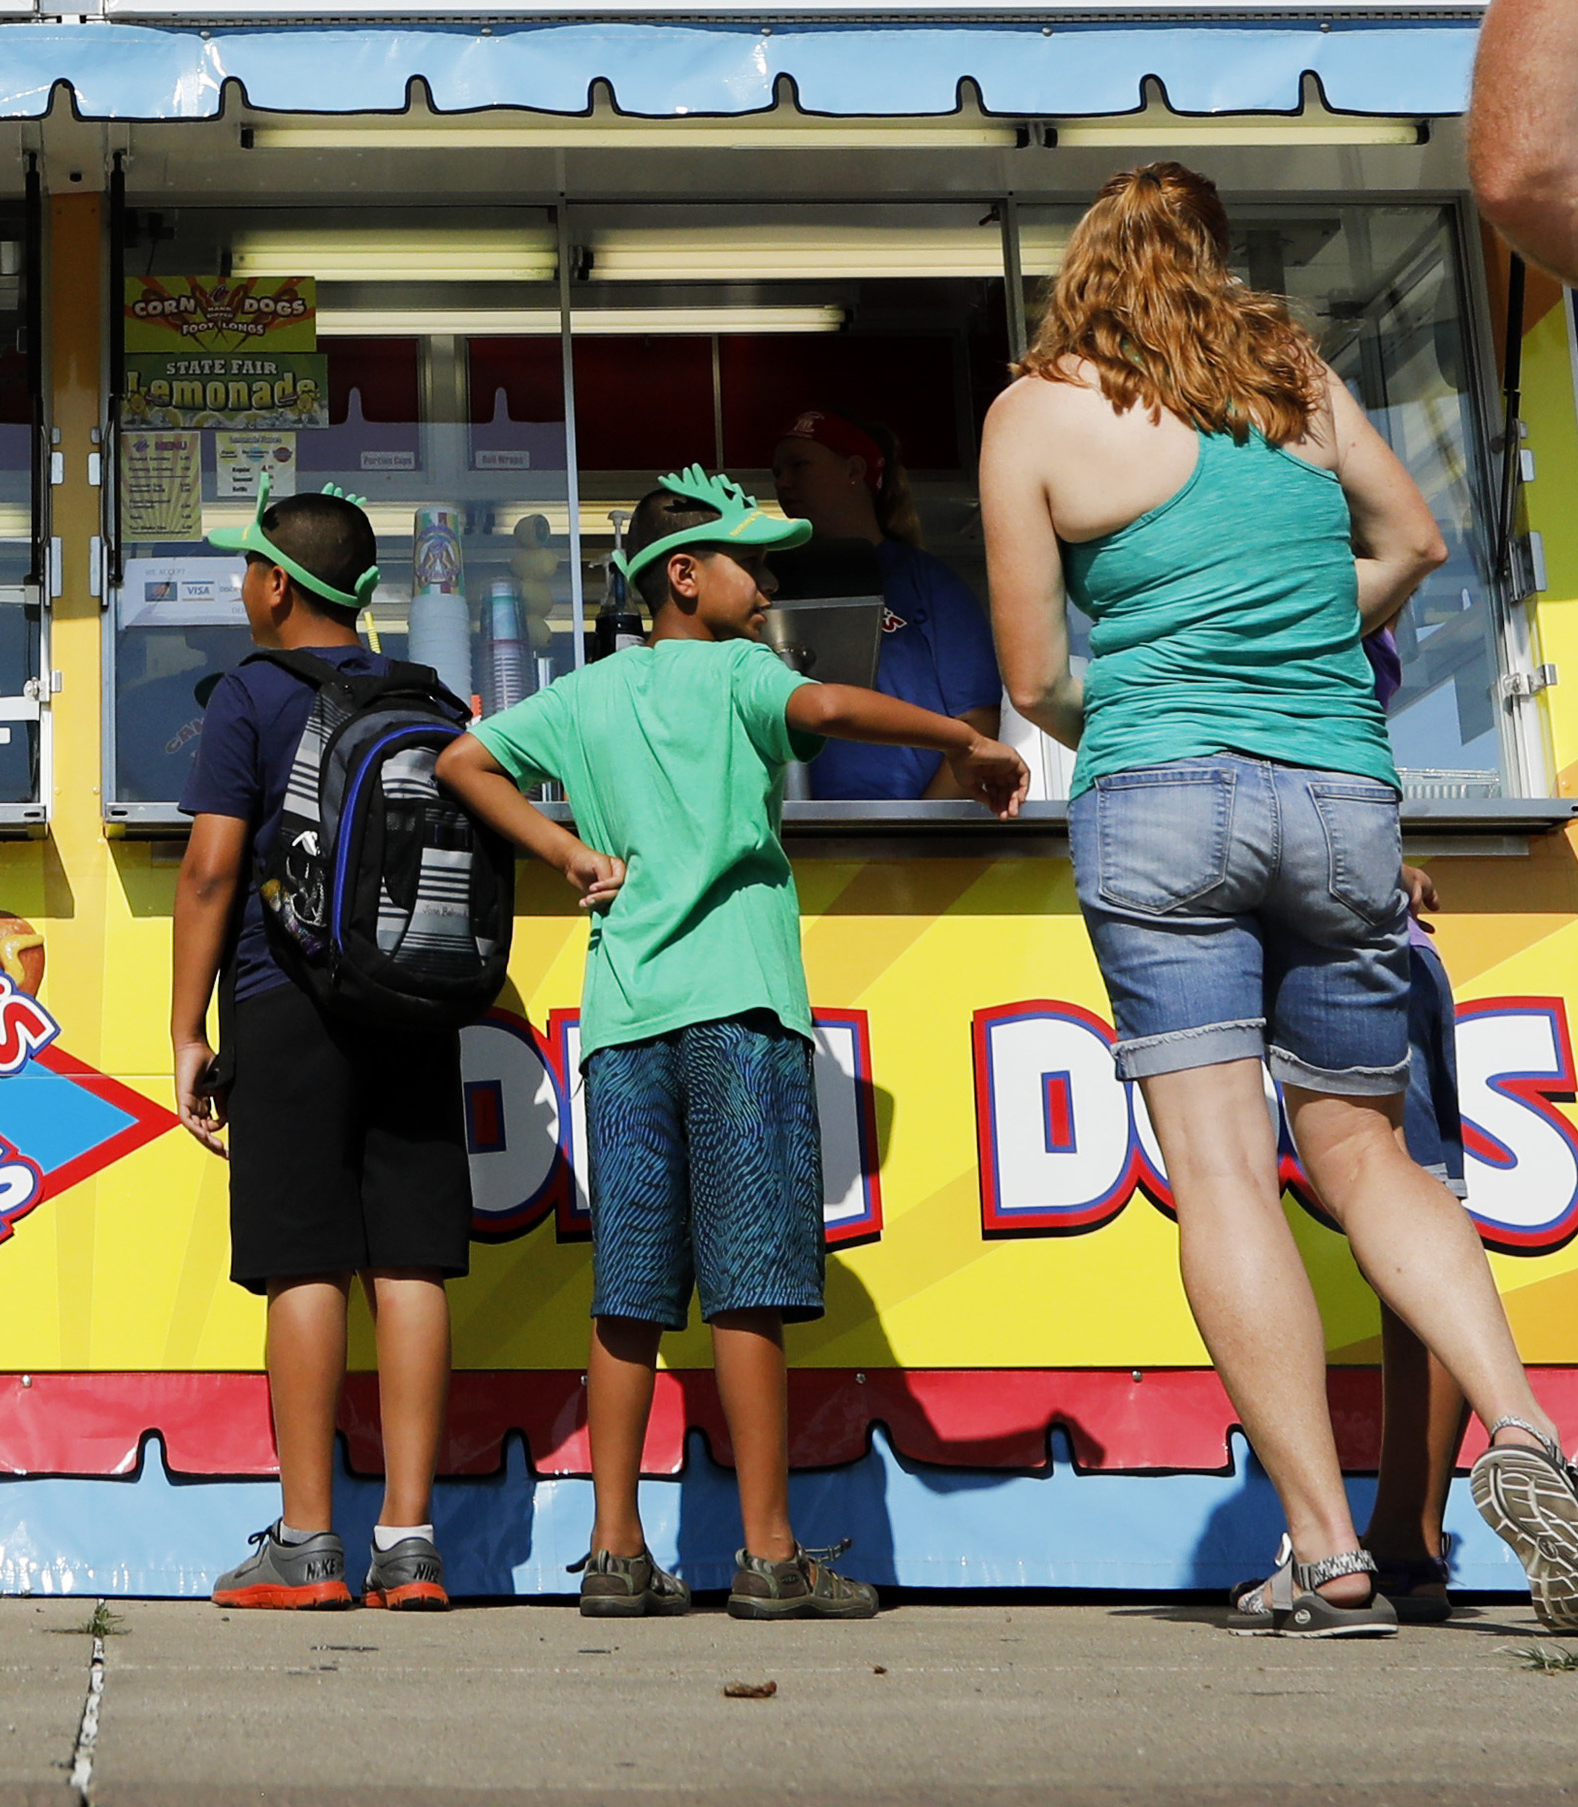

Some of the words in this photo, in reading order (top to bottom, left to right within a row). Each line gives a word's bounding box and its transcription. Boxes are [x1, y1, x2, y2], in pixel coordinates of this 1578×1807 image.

[133, 296, 196, 318] CORN
[242, 296, 307, 318] DOGS
[182, 321, 215, 335] FOOT
[222, 322, 265, 335] LONGS
[166, 360, 226, 375] STATE
[231, 360, 278, 375] FAIR
[126, 371, 319, 412] Lemonade
[186, 586, 210, 595] VISA
[305, 1558, 336, 1581] NIKE
